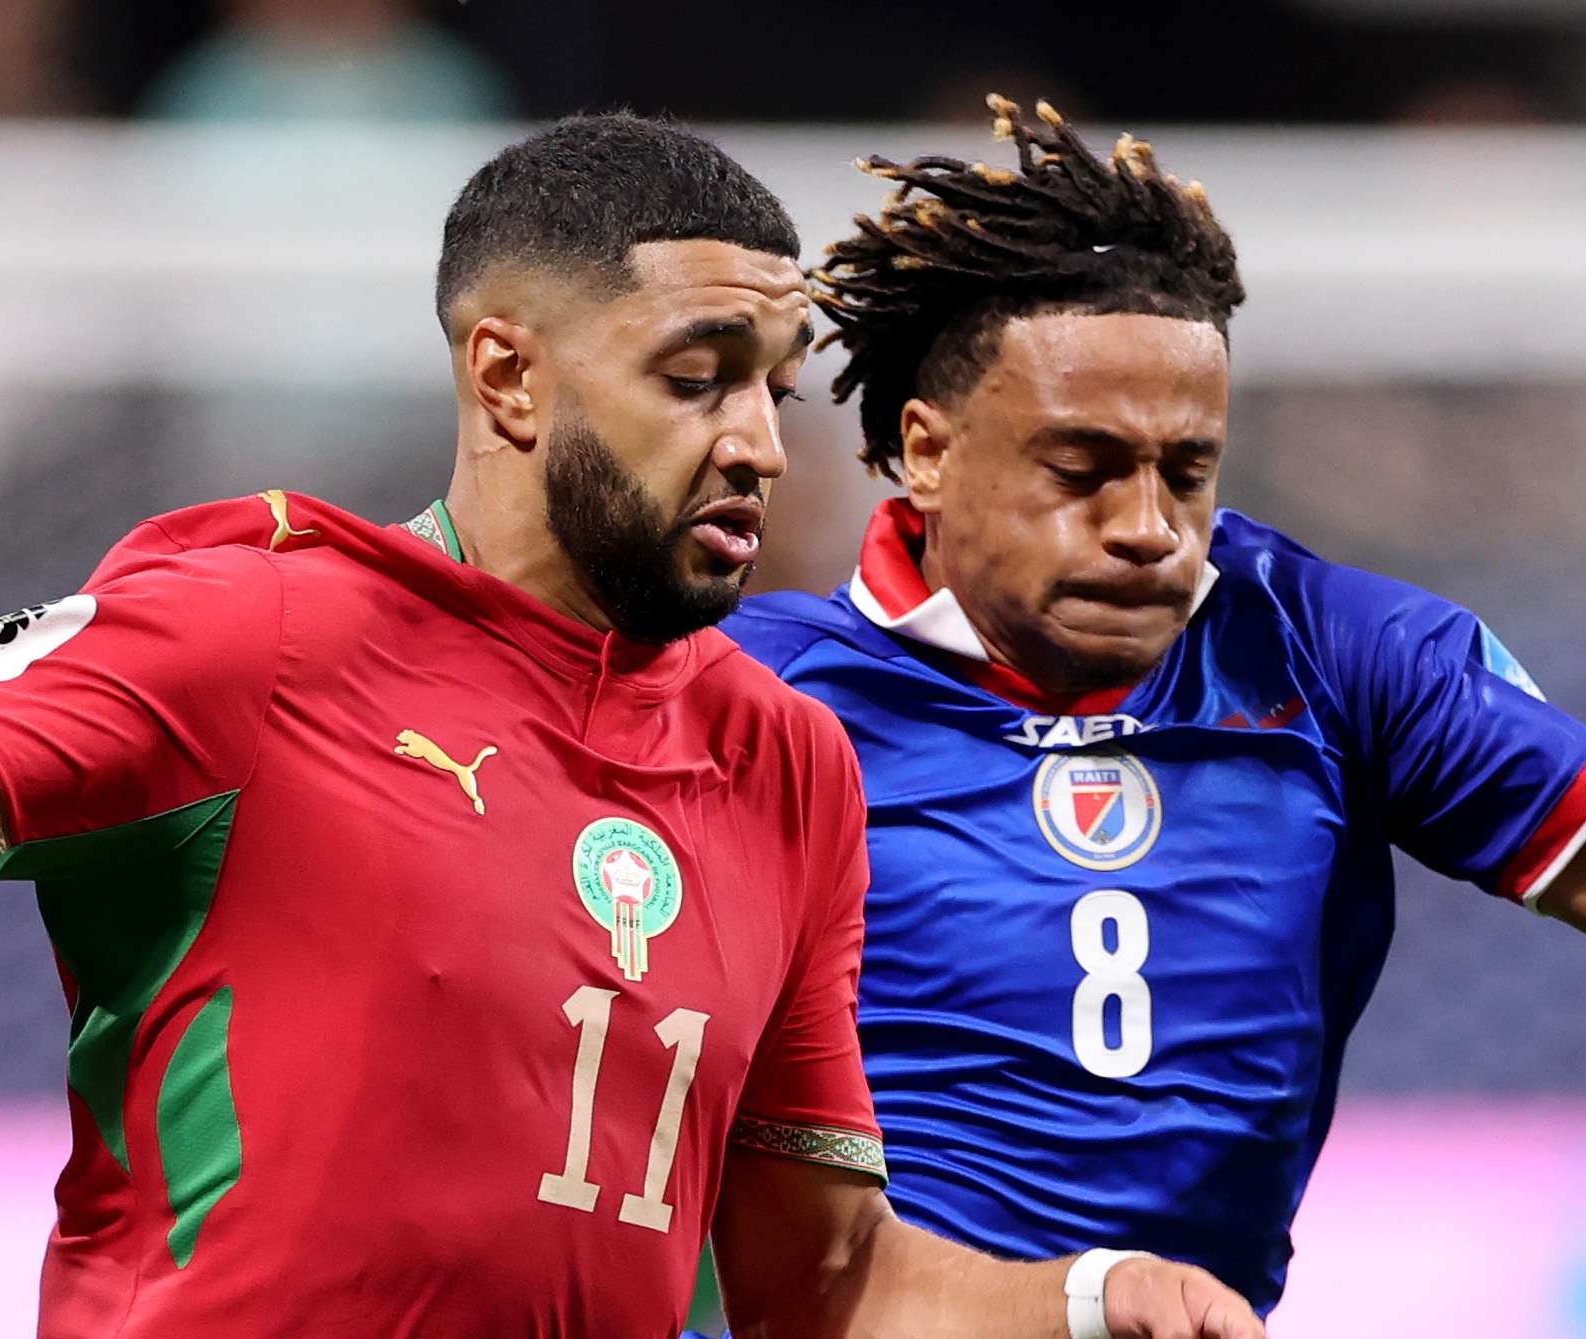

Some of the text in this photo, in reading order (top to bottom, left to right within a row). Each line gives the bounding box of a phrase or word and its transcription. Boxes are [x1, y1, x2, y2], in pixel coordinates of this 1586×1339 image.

[1002, 714, 1161, 748] SAET
[1070, 889, 1152, 1078] 8
[537, 985, 711, 1234] 11
